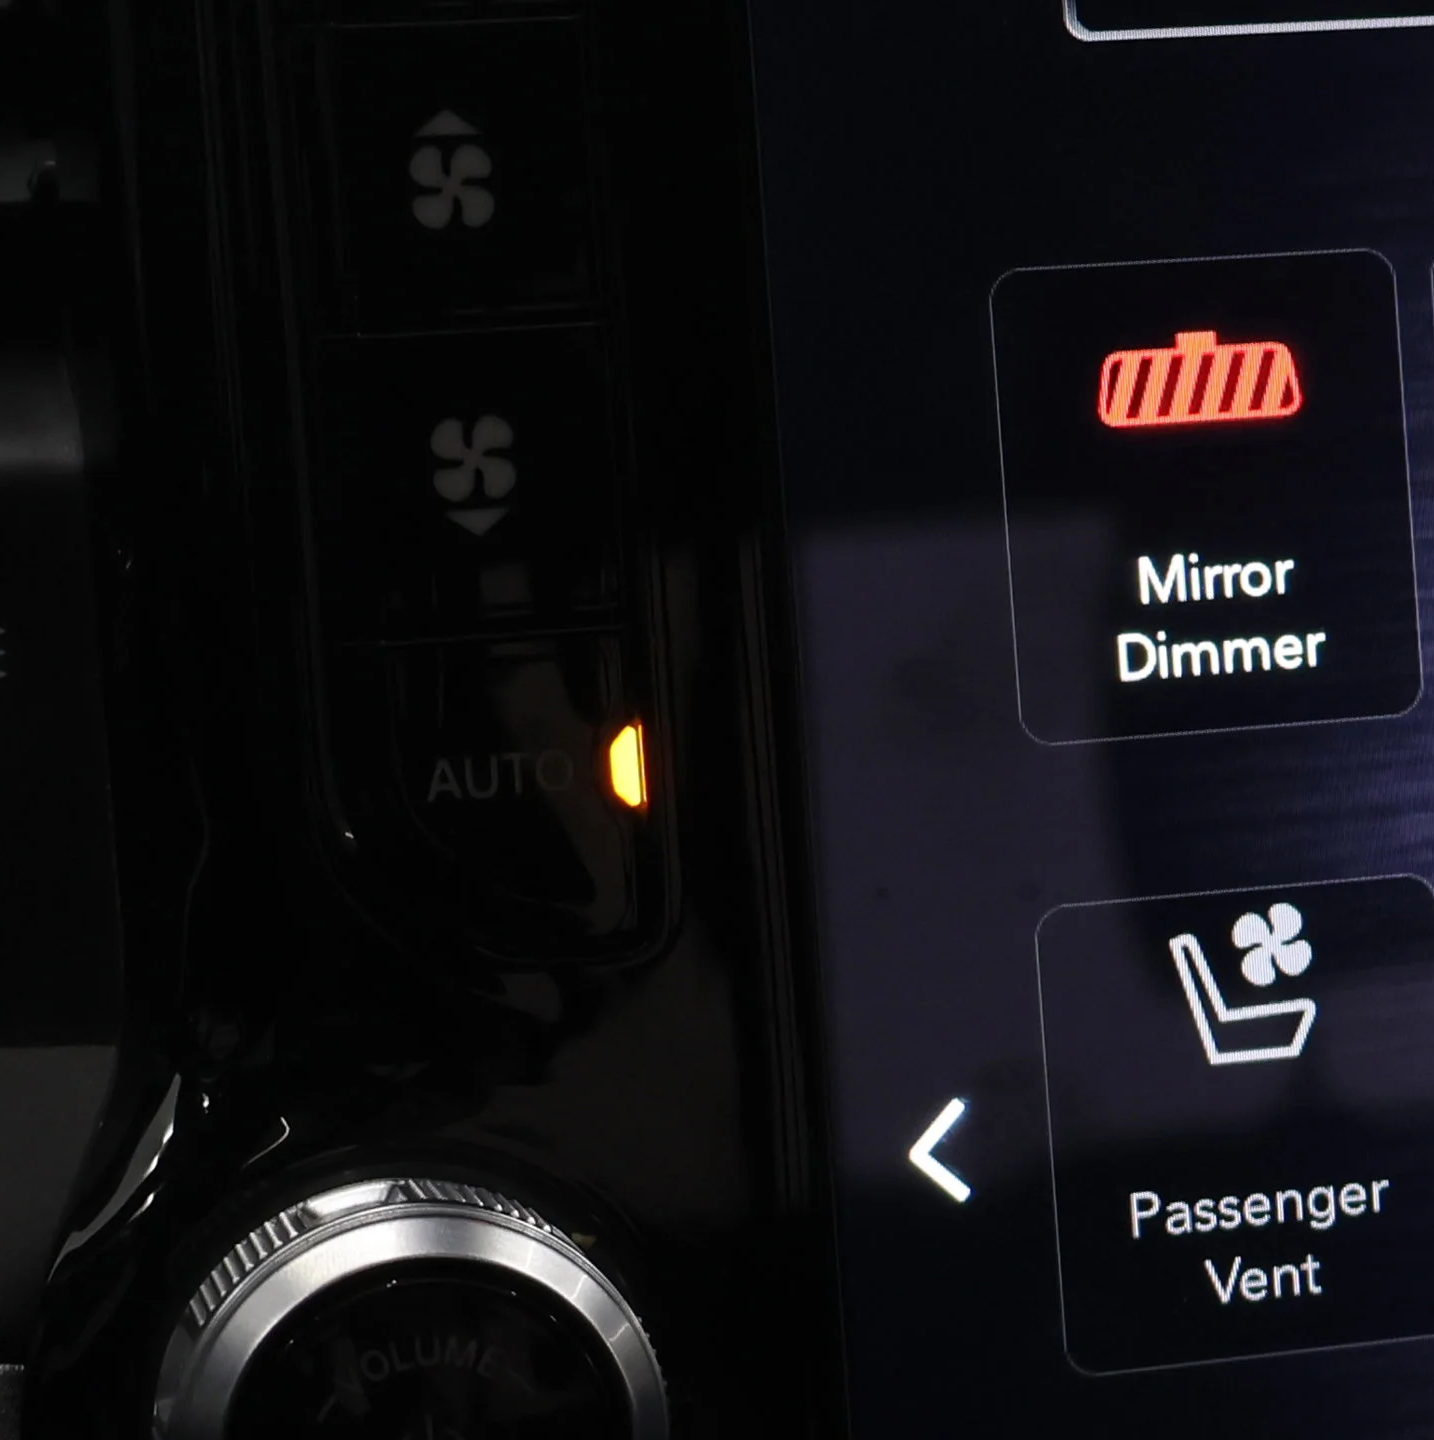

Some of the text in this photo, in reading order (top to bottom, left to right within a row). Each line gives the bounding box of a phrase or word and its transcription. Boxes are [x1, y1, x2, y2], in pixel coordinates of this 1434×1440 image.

[1137, 552, 1295, 605] Mirror
[1116, 630, 1327, 683] Dimmer
[426, 749, 574, 803] AUTO
[1130, 1179, 1390, 1239] Passenger
[1204, 1253, 1322, 1304] Vent
[332, 1333, 508, 1410] VOLUME
